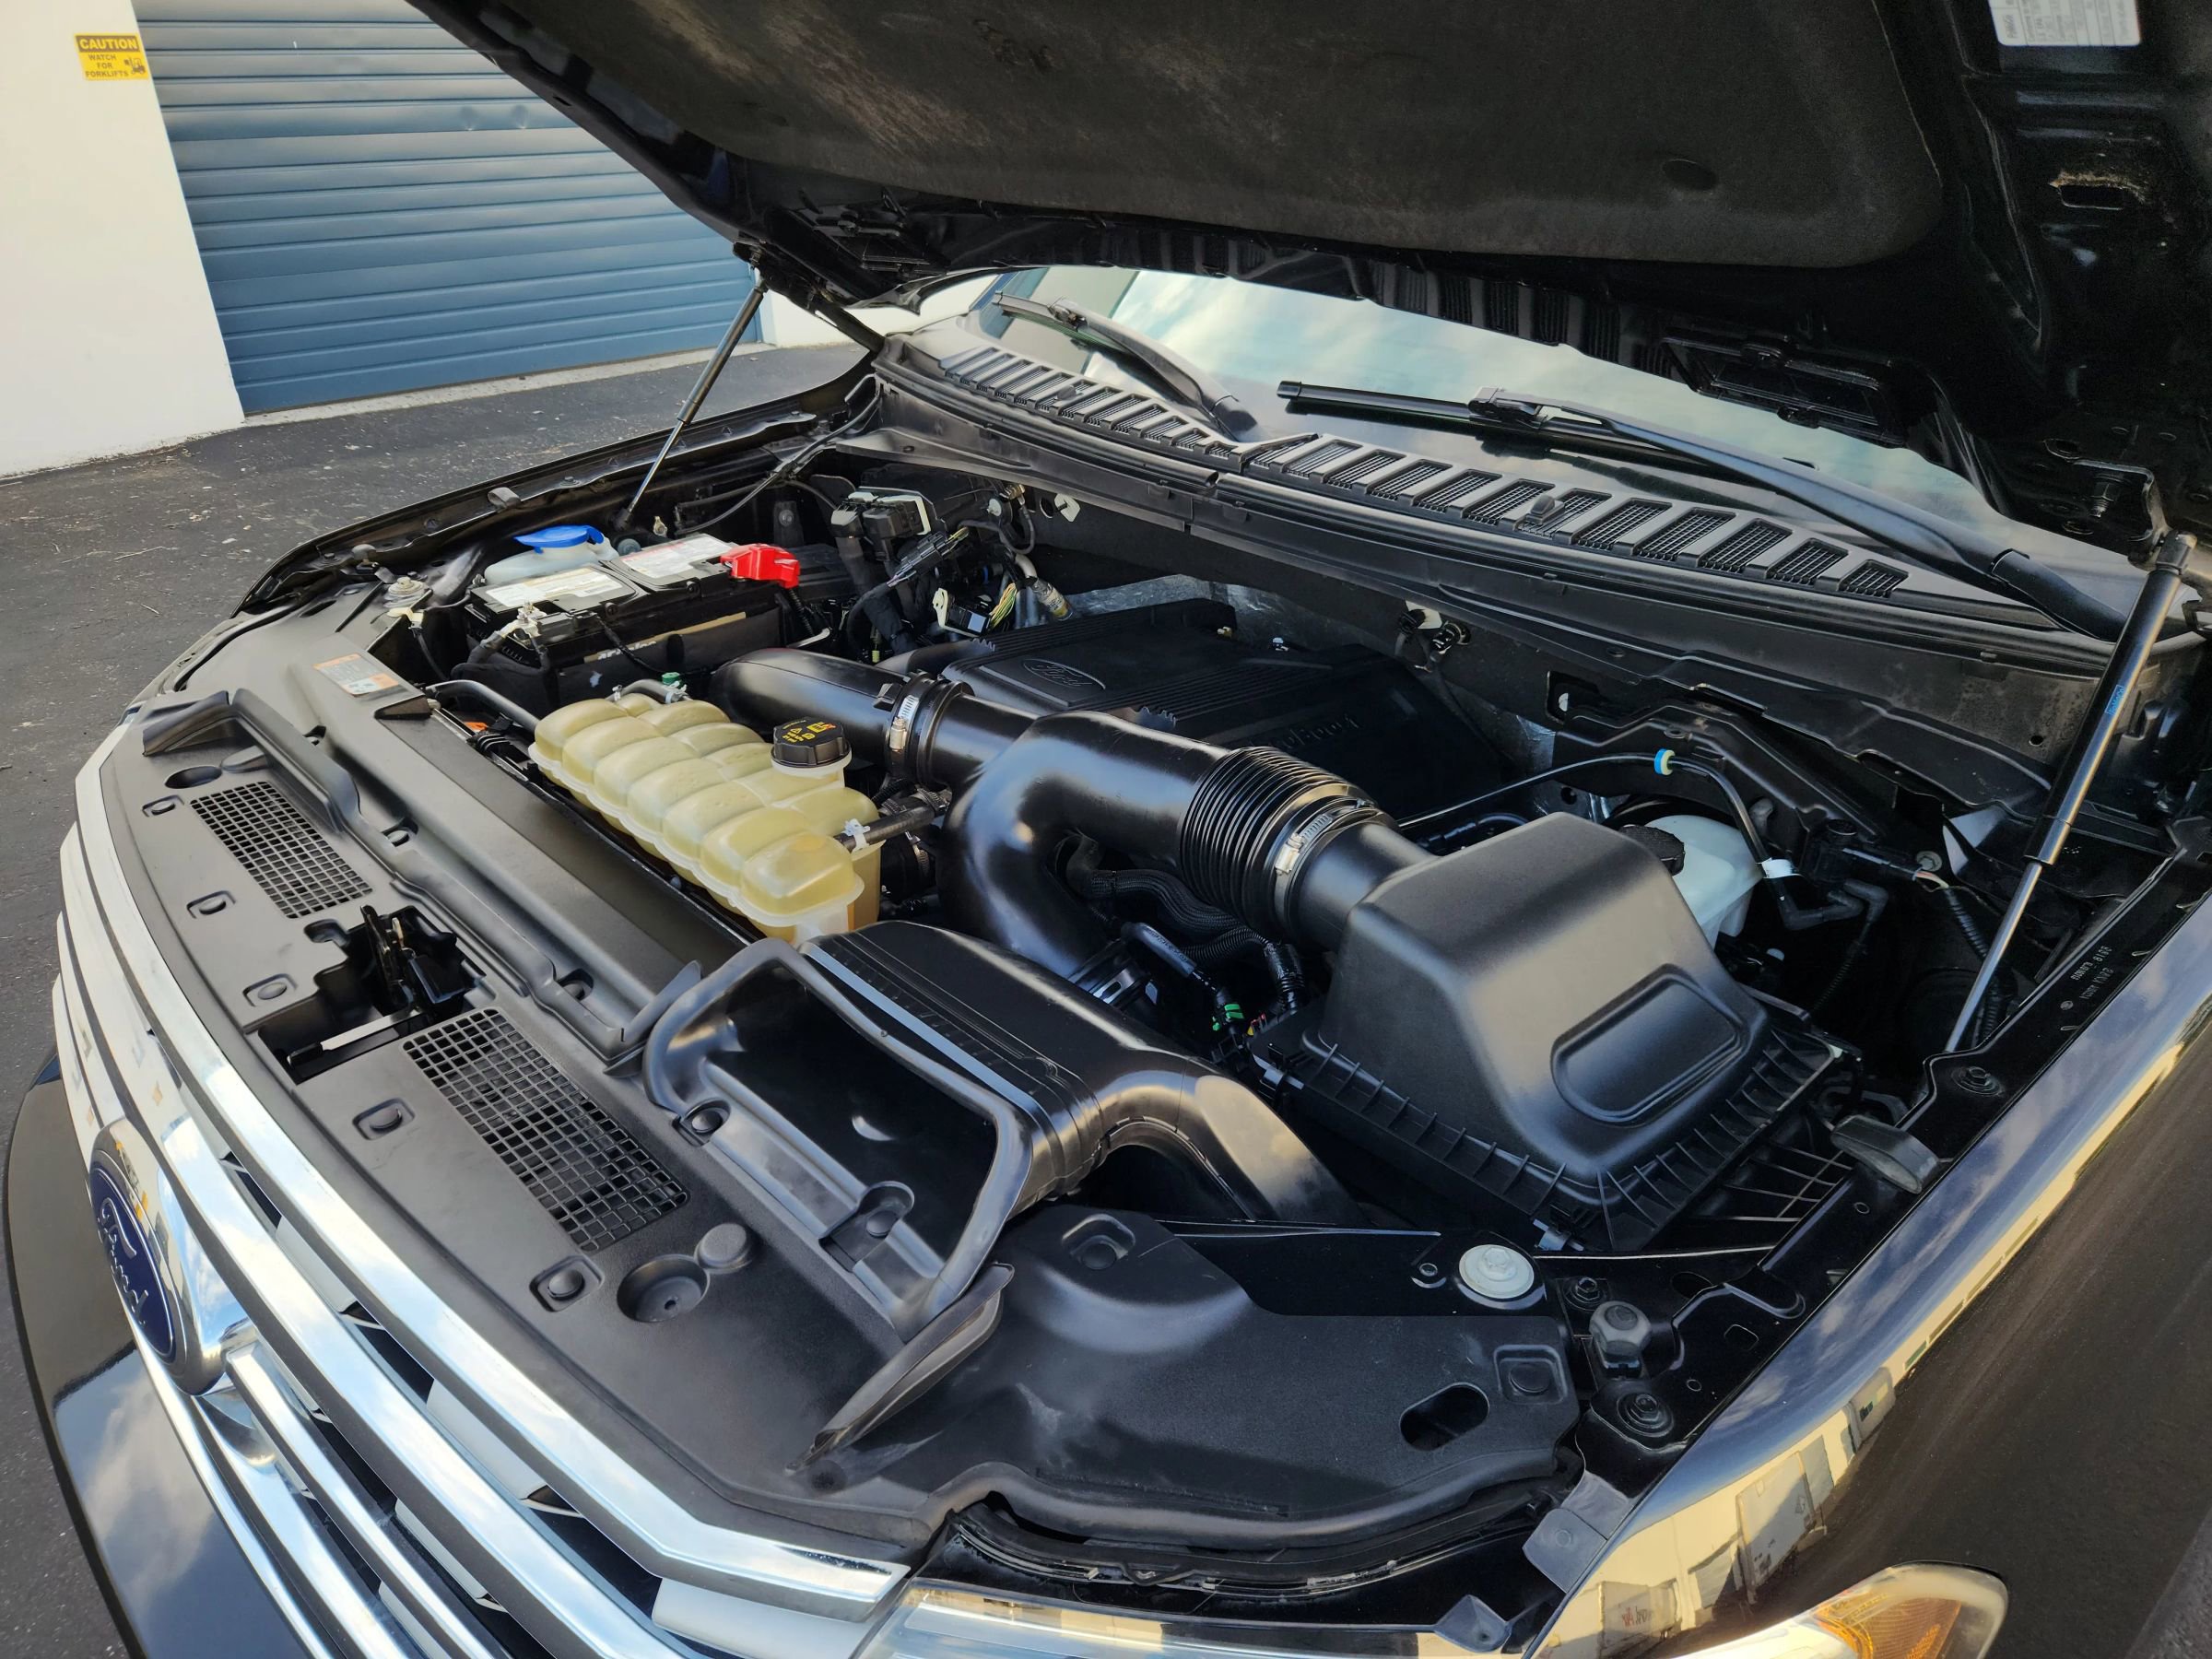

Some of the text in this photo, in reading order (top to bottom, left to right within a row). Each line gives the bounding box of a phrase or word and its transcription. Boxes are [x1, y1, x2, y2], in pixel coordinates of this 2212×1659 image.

[79, 38, 138, 50] CAUTION
[86, 70, 129, 78] FORKLIFTS
[96, 1197, 149, 1325] Ford
